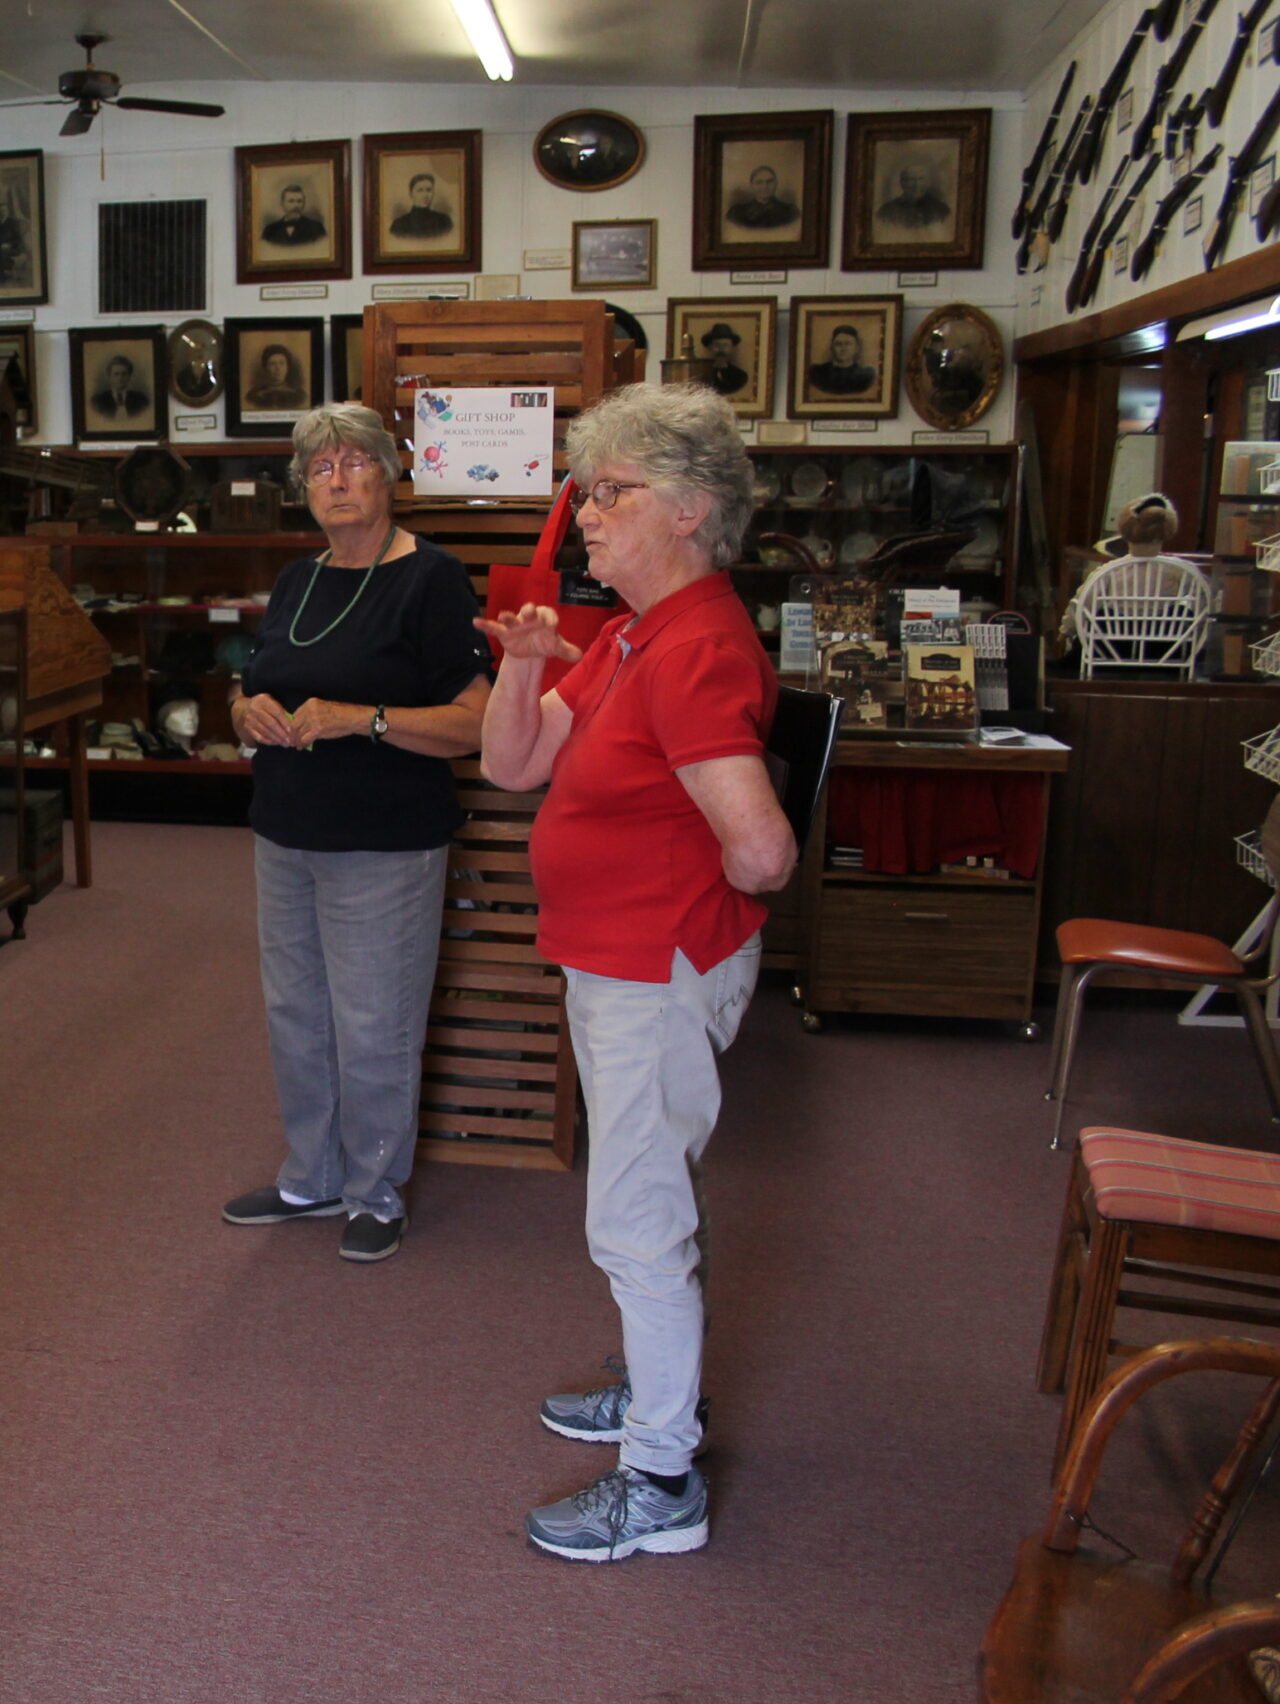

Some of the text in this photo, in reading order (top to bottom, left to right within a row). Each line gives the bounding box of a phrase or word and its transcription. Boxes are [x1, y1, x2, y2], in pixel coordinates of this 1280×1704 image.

[455, 412, 516, 423] GIFT SHOP
[461, 440, 508, 448] POST CARDS
